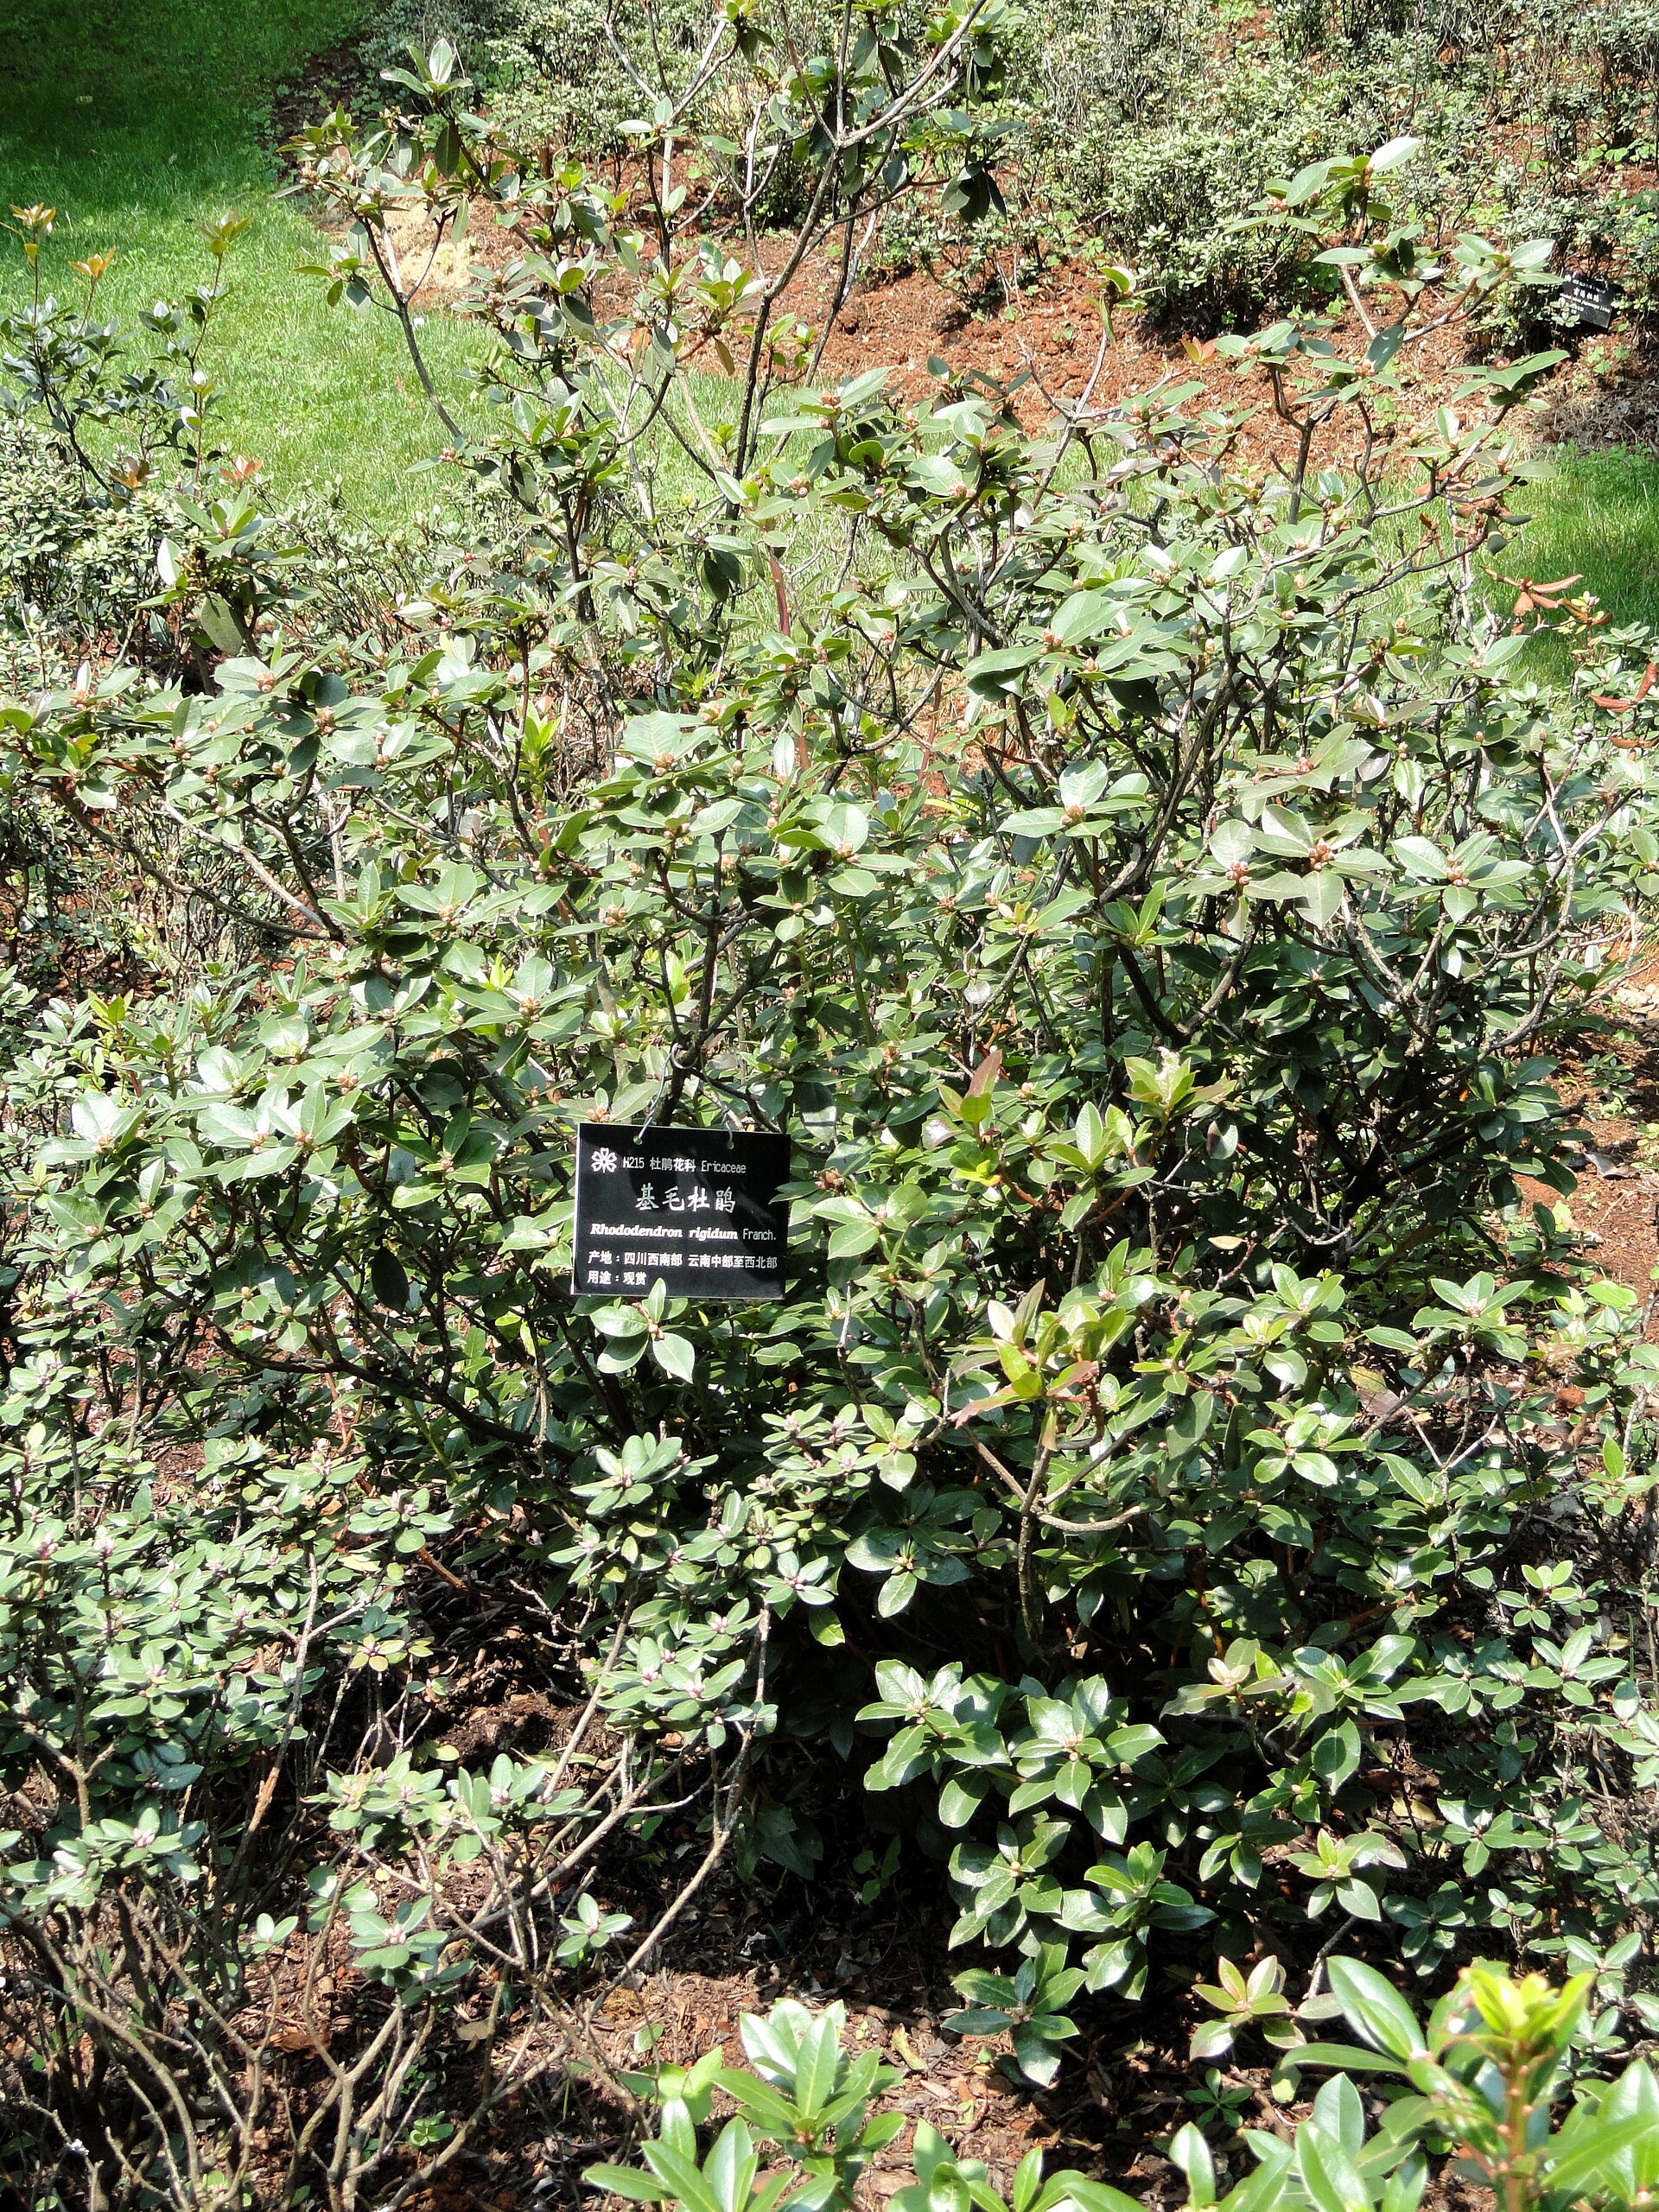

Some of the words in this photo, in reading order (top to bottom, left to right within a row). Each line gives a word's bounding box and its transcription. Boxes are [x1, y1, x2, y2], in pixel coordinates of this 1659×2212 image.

[649, 1157, 696, 1173] 杜鹃花科
[701, 1160, 747, 1173] Ericaceae
[634, 1182, 736, 1214] 基毛杜鹃
[590, 1223, 683, 1238] Rhododendron
[689, 1227, 739, 1242] rigidum
[742, 1228, 777, 1241] Franch.
[687, 1254, 778, 1269] 云南中部至西北部
